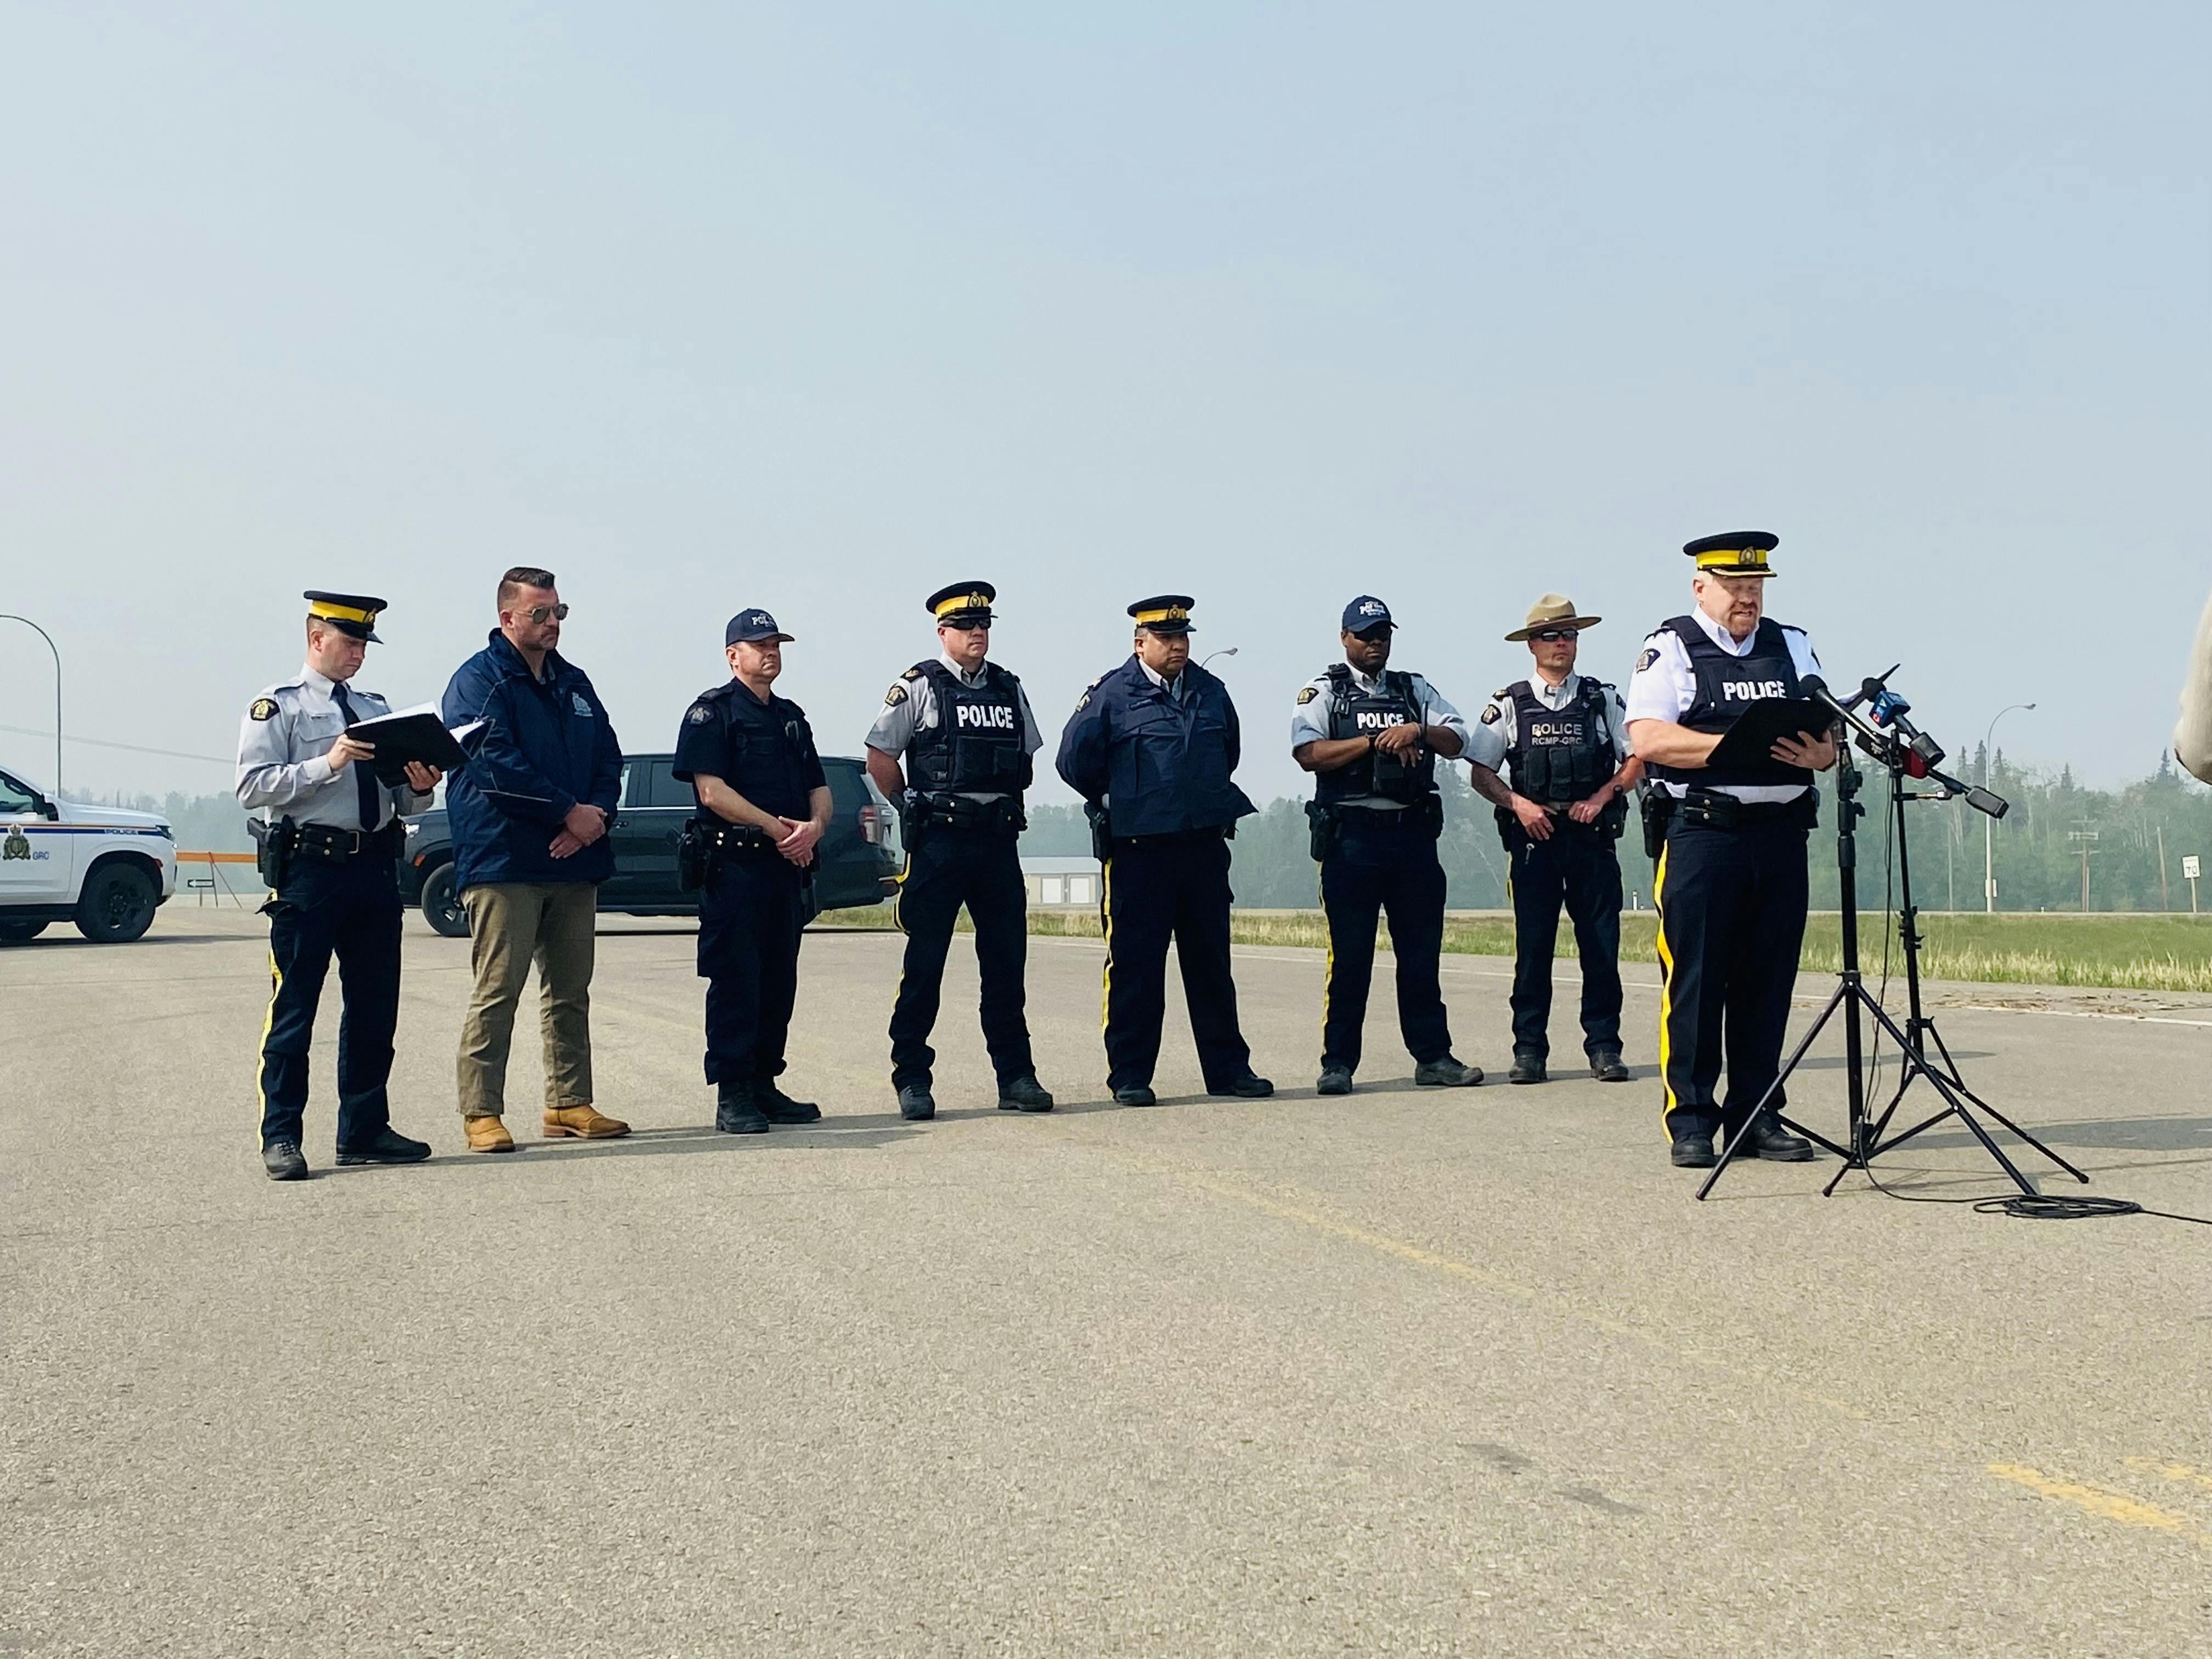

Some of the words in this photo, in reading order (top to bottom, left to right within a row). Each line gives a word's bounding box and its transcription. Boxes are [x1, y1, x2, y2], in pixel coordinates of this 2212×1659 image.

[1722, 680, 1787, 701] POLICE
[956, 705, 1014, 729] POLICE
[1357, 713, 1404, 729] POLICE
[1532, 723, 1582, 735] POLICE
